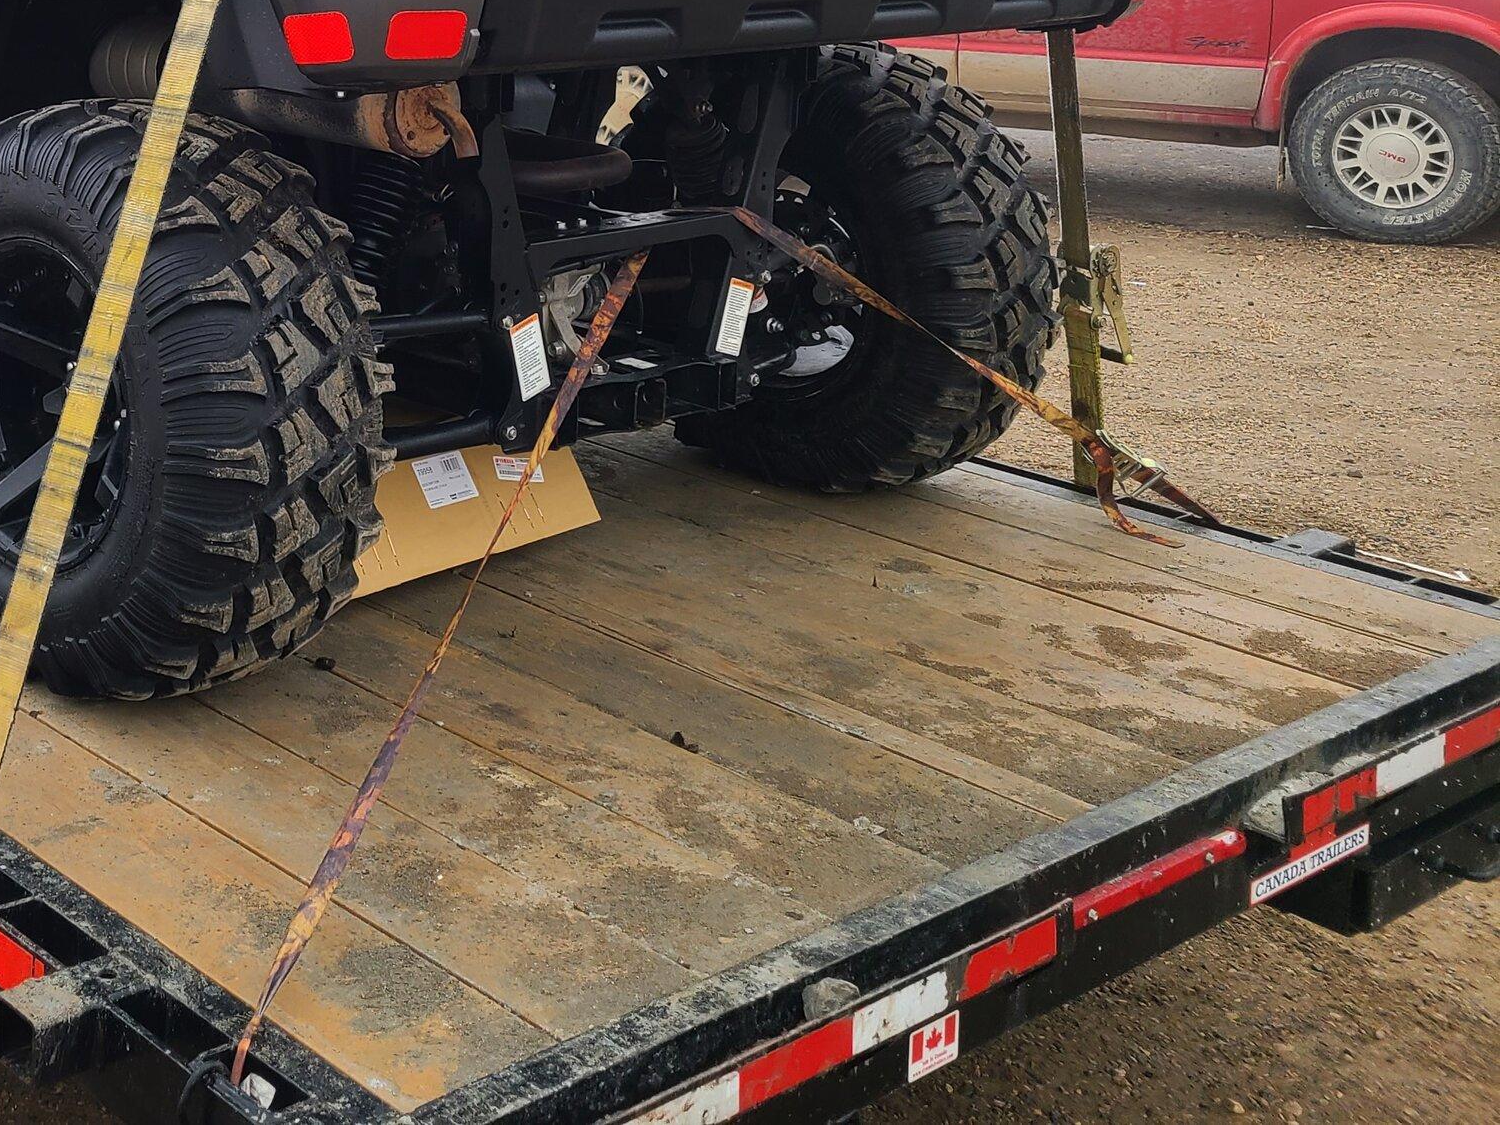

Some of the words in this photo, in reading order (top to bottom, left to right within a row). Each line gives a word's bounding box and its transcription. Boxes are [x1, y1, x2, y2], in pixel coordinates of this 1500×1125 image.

[1324, 88, 1380, 122] TERRAIN
[1379, 149, 1407, 164] GMC
[1381, 169, 1472, 225] MOTOMASTER
[1255, 860, 1306, 897] CANADA
[1310, 829, 1365, 869] TRAILERS
